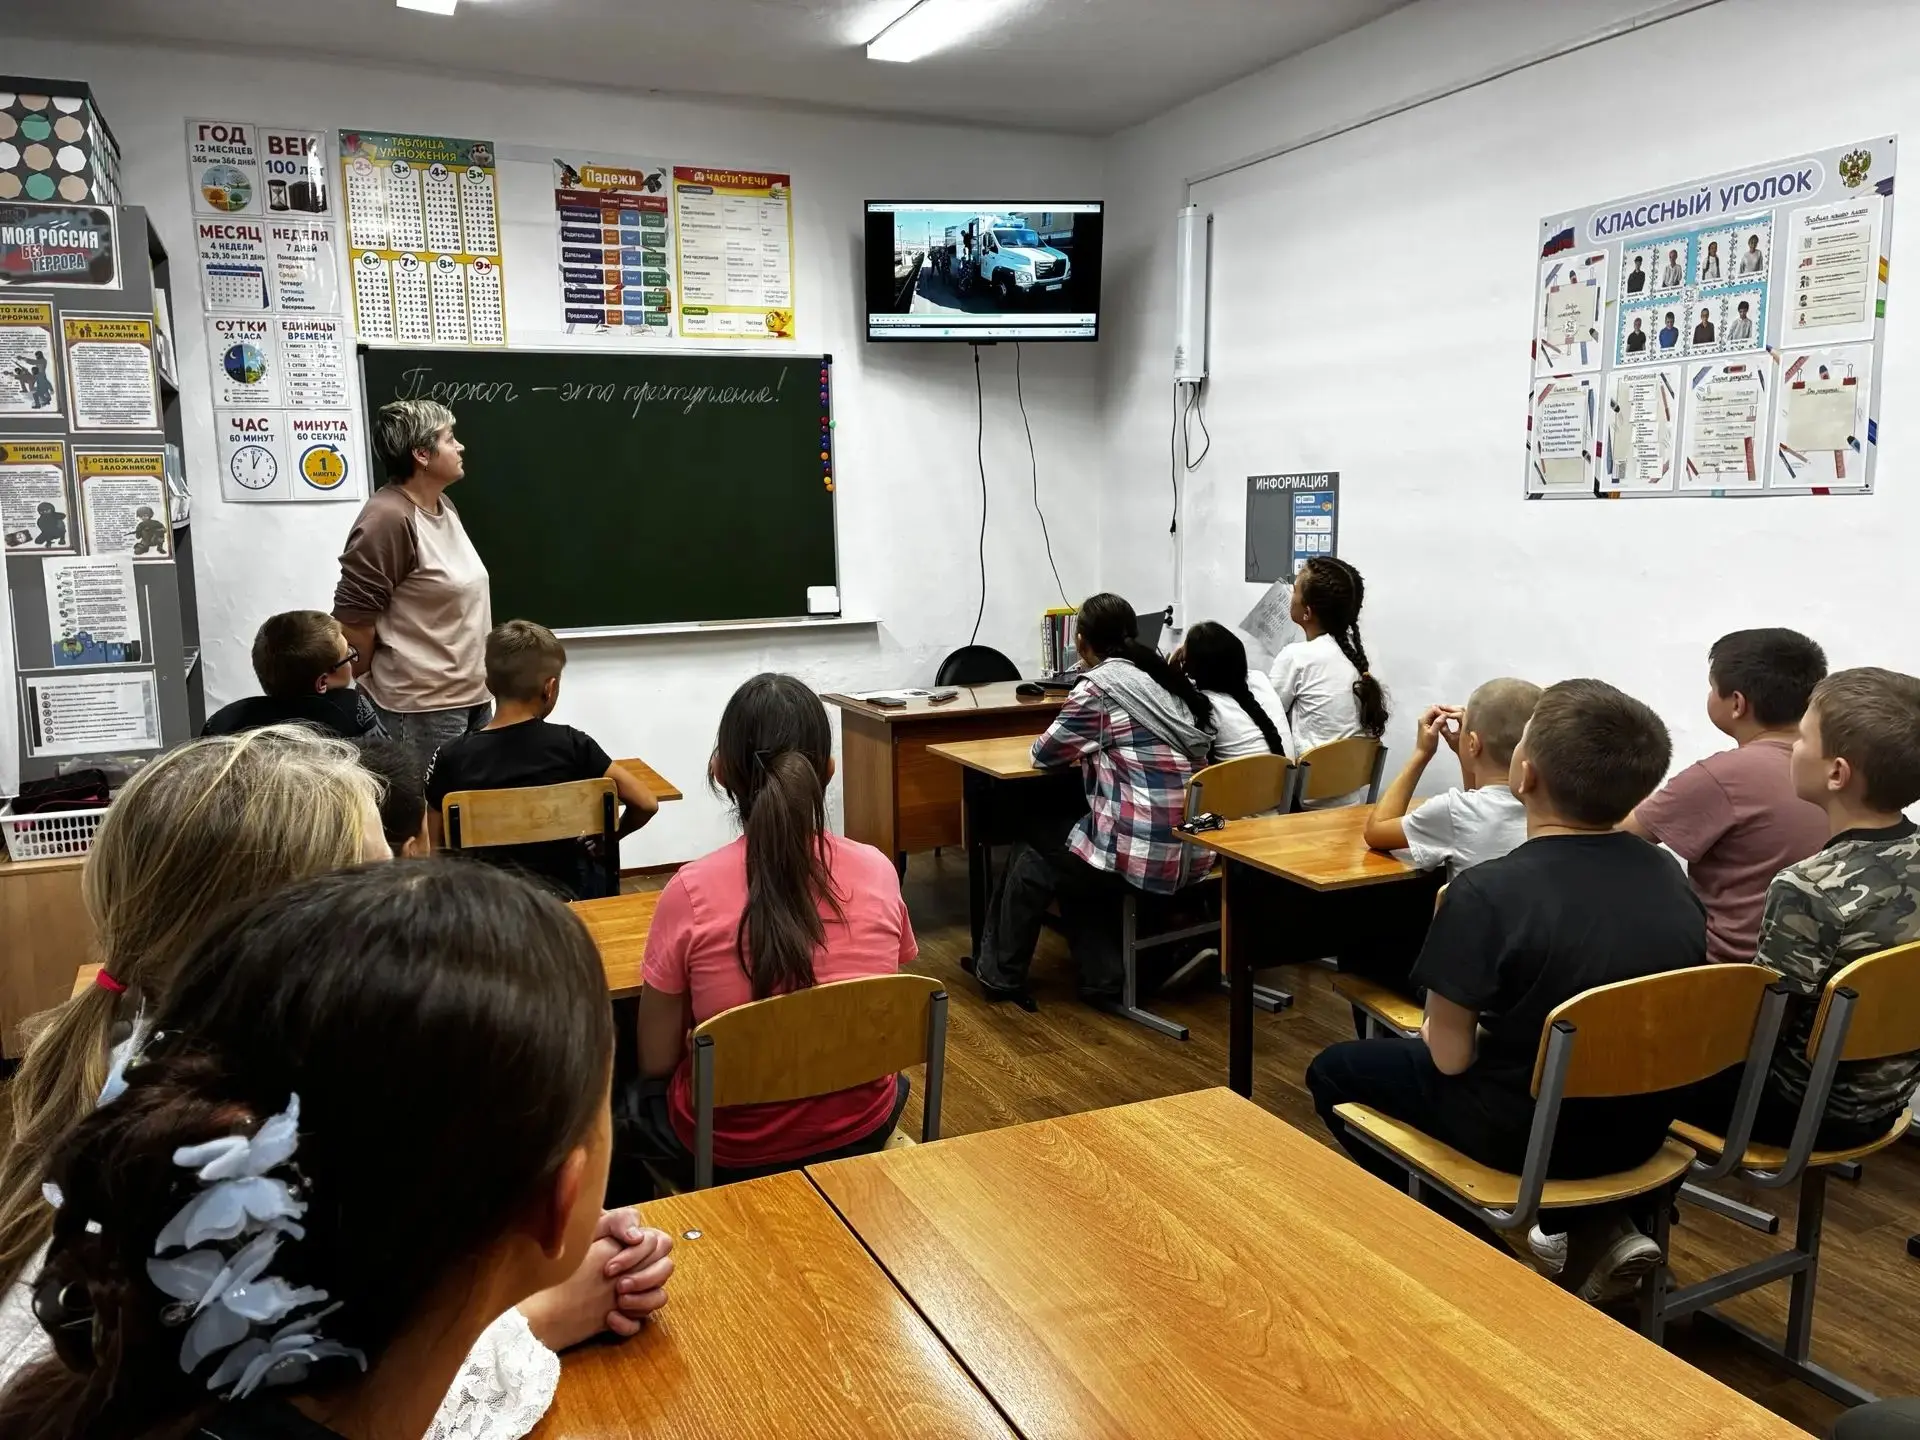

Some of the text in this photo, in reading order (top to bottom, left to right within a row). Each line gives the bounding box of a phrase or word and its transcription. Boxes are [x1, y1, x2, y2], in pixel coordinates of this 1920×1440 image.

[199, 125, 246, 145] ГОД
[195, 145, 253, 155] 12 МЕСЯЦЕВ
[391, 137, 445, 150] ТАБЛИЦА
[192, 156, 207, 164] 365
[221, 157, 236, 165] 366
[380, 148, 457, 161] УМНОЖЕНИЯ
[265, 160, 296, 175] 100
[586, 169, 637, 186] Падежи
[706, 174, 768, 185] ЧАСТИ РЕЧИ
[1595, 169, 1812, 237] КЛАССНЫЙ УГОЛОК
[1, 226, 99, 249] МОЯ РОССИЯ
[200, 225, 262, 242] МЕСЯЦ
[272, 228, 328, 241] НЕДЕЛЯ
[21, 244, 44, 259] БЕЗ
[210, 242, 254, 251] 4 НЕДЕЛИ
[286, 244, 291, 252] 7
[31, 253, 86, 272] ТЕРРОРА
[567, 292, 600, 300] Творительный
[568, 312, 598, 320] Предложный
[216, 320, 267, 332] СУТКИ
[282, 322, 336, 332] ЕДИНИЦЫ
[394, 366, 519, 410] Поджог
[559, 382, 616, 402] это
[623, 366, 788, 419] преступление!
[232, 418, 269, 432] ЧАС
[293, 420, 348, 431] МИНУТА
[243, 434, 274, 442] МИНУТ
[311, 433, 346, 441] СЕКУНД
[319, 457, 326, 470] 1
[1256, 474, 1328, 490] ИНФОРМАЦИЯ
